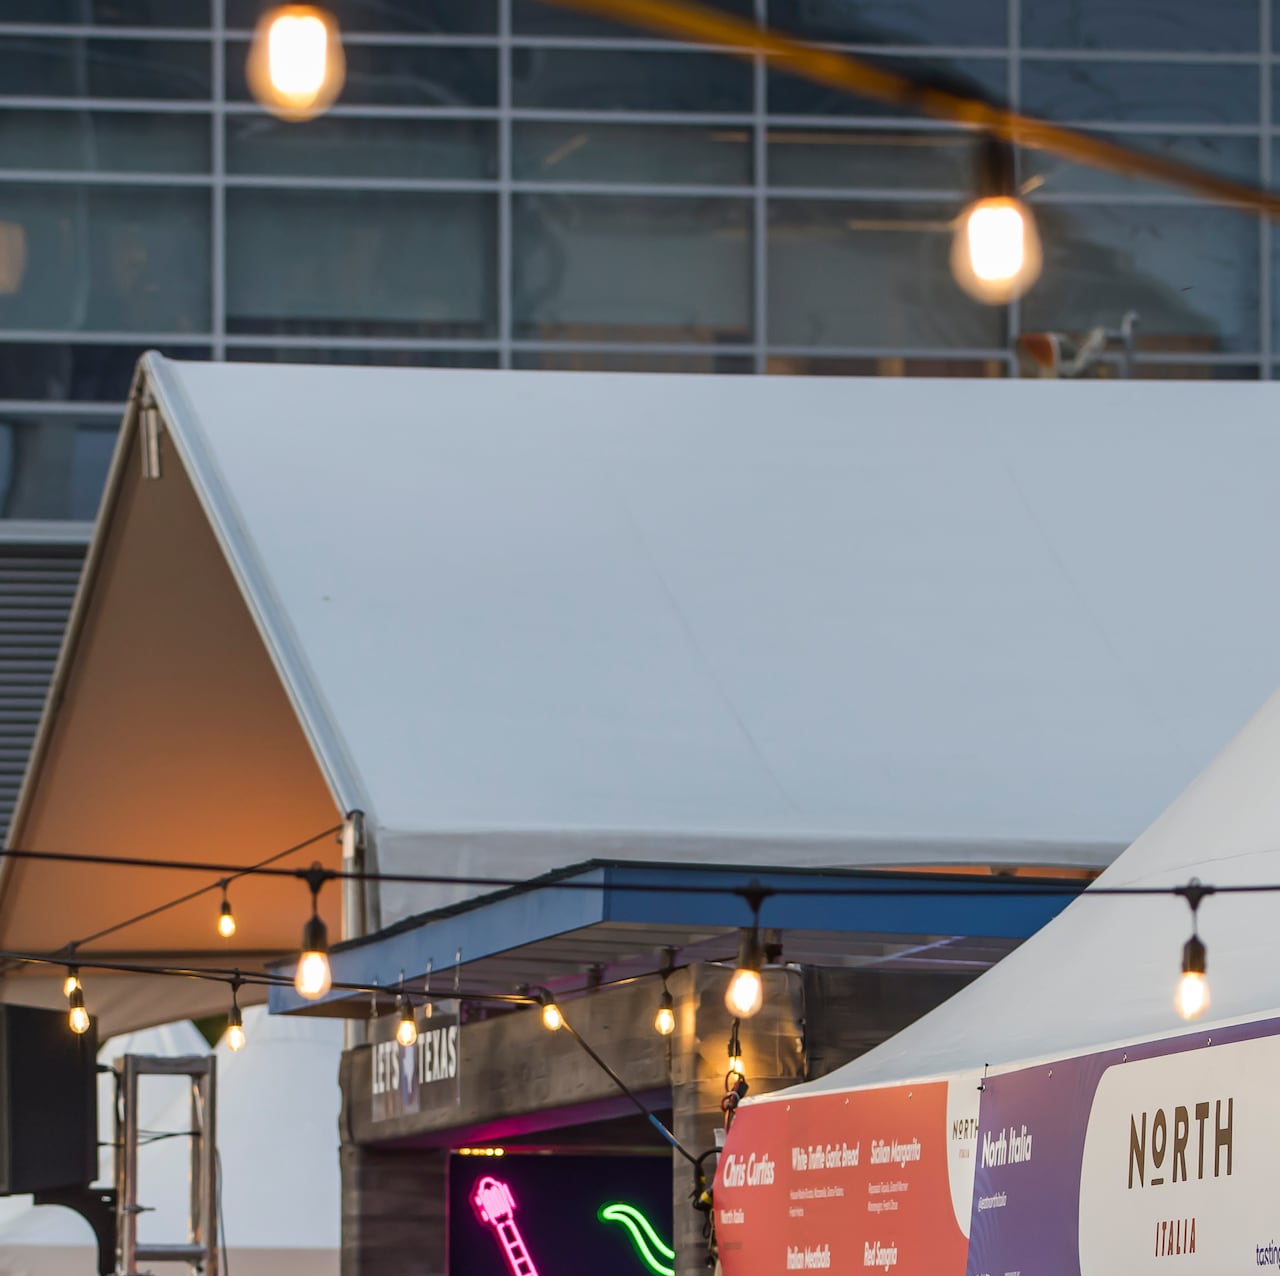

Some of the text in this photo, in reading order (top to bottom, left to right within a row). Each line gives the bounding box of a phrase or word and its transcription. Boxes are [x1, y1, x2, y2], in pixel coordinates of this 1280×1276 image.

[417, 1025, 458, 1084] TEXAS
[792, 1146, 807, 1171] White
[842, 1142, 860, 1167] Bread
[981, 1124, 1032, 1168] North Italia
[1128, 1098, 1233, 1189] NORTH
[723, 1152, 775, 1187] Chris Curtiss
[864, 1241, 875, 1266] Red
[1155, 1218, 1196, 1257] ITALIA
